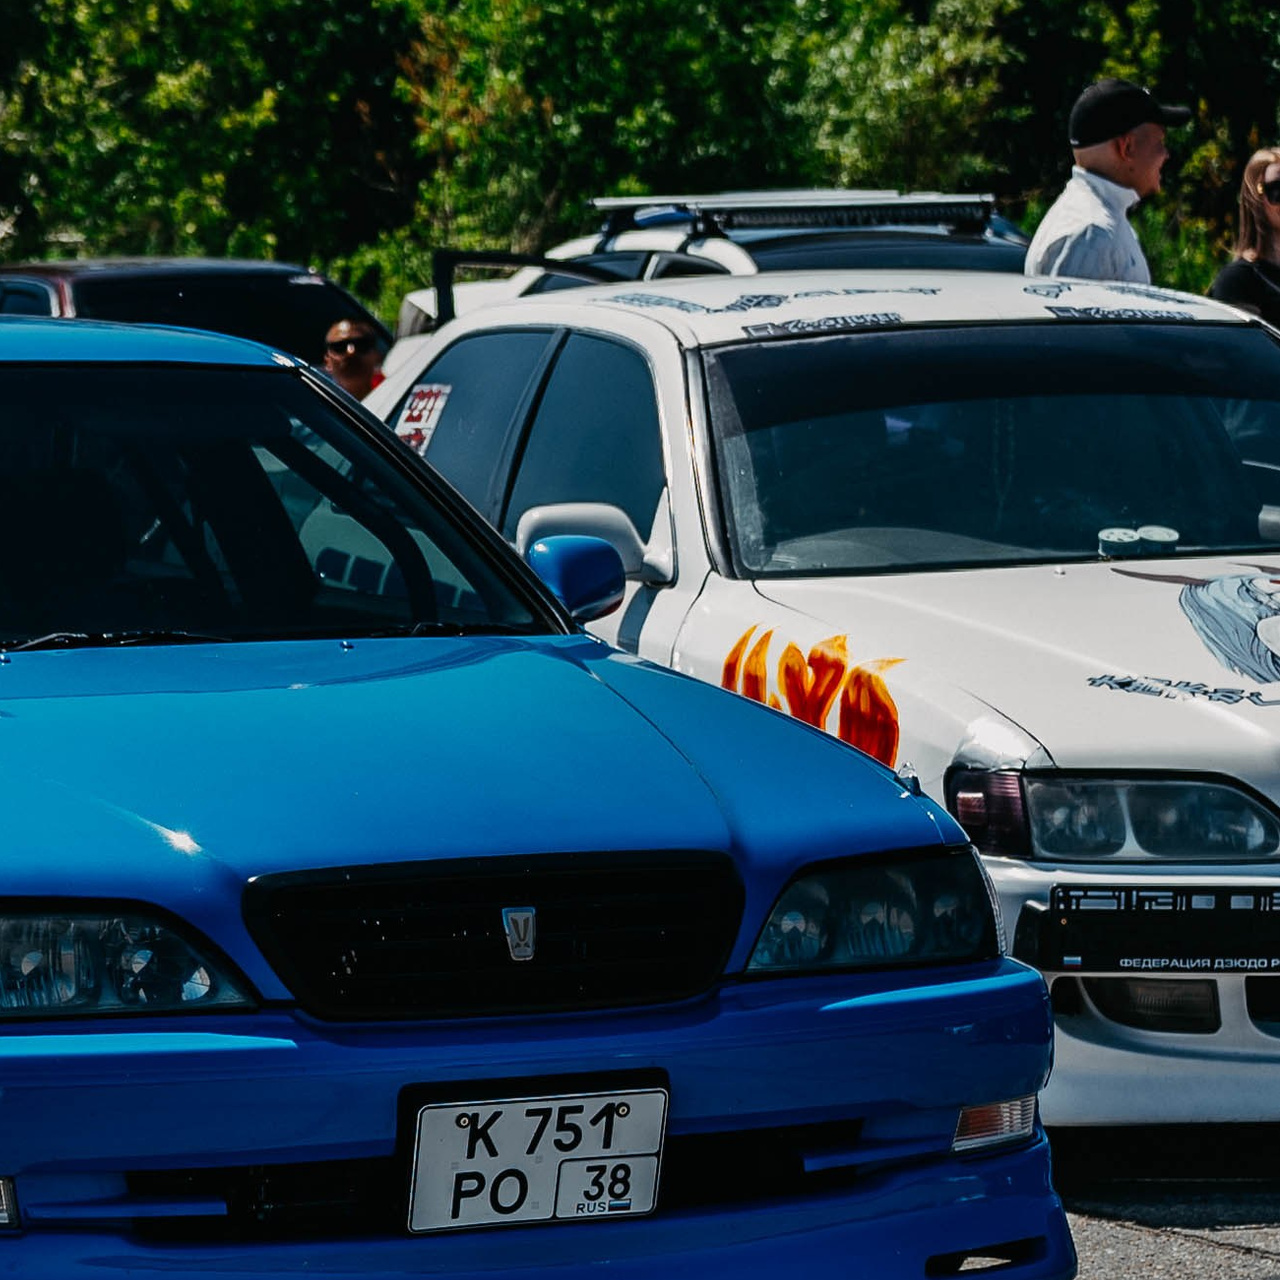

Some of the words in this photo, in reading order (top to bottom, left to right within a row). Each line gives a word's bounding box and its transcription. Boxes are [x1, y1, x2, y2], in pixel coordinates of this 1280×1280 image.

[1119, 958, 1210, 969] ФЕДЕРАЦИЯ
[1214, 958, 1268, 969] ДЗЮДО
[524, 1102, 616, 1155] 751
[583, 1163, 632, 1202] 38
[576, 1201, 607, 1214] RUS
